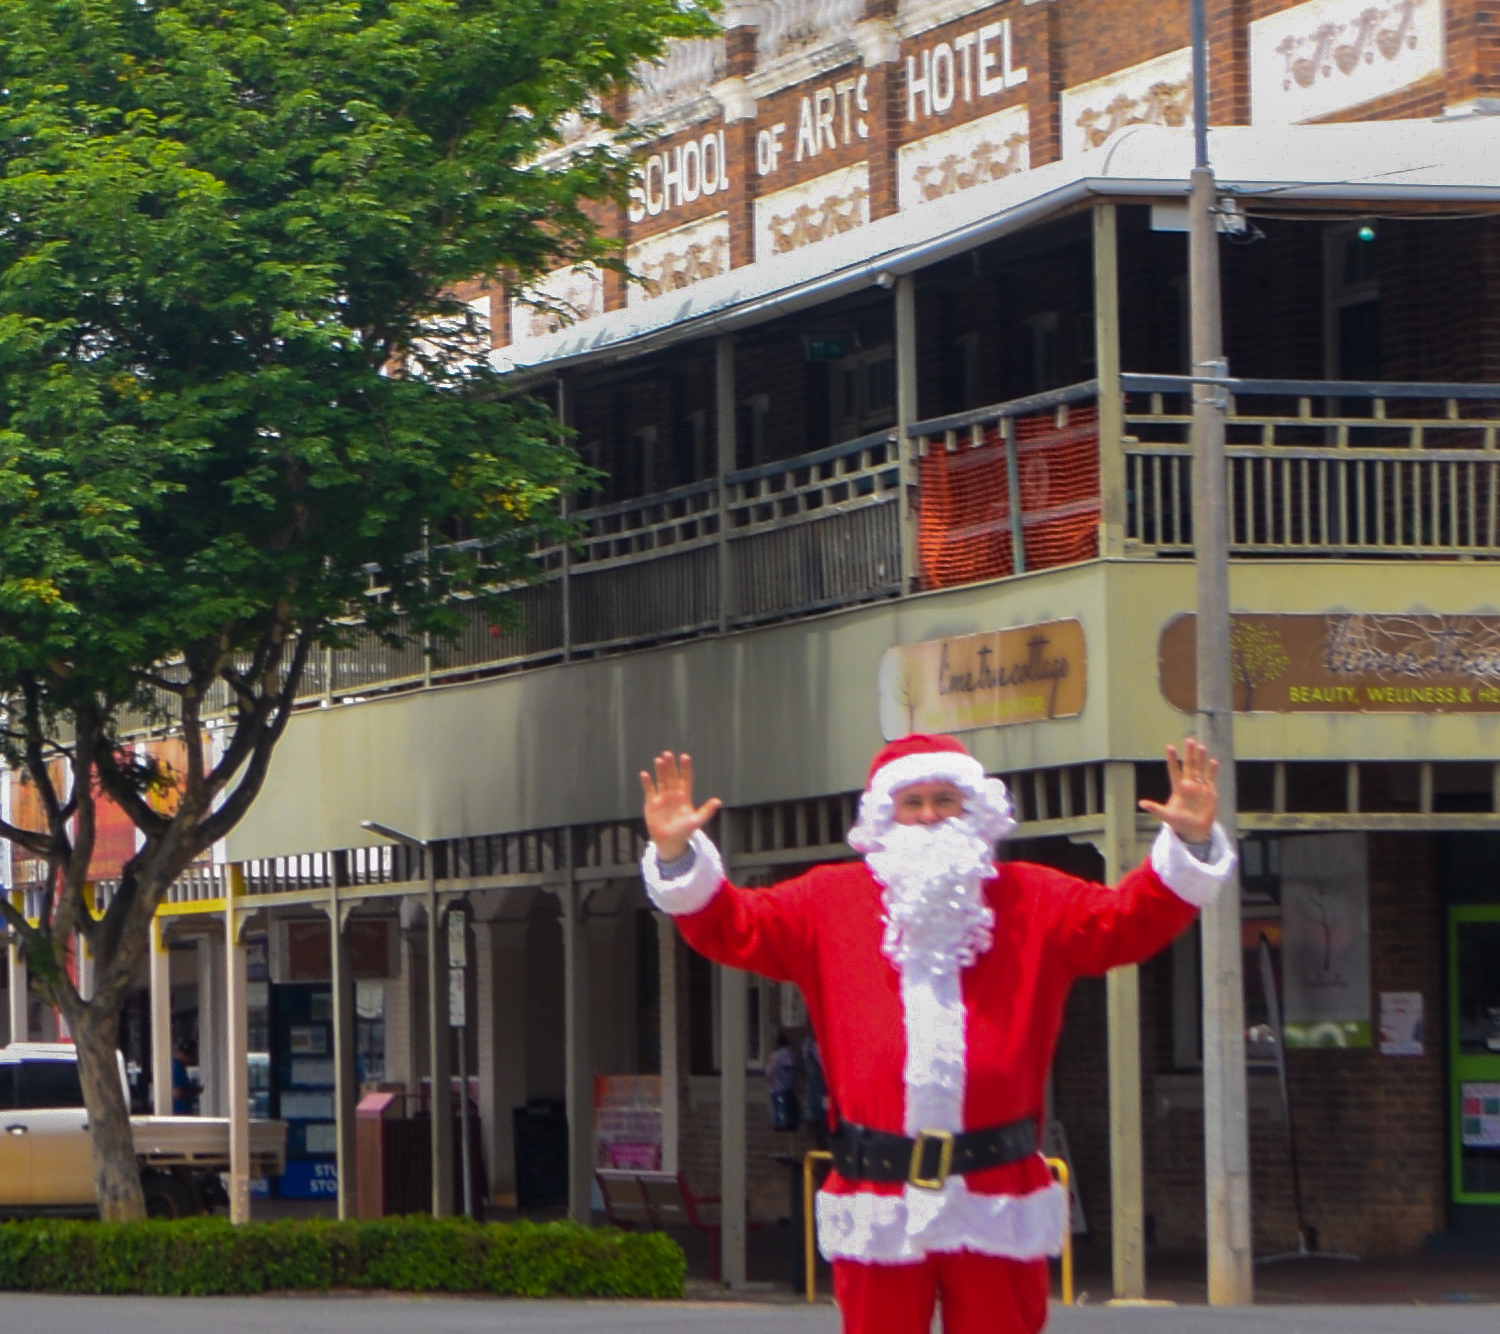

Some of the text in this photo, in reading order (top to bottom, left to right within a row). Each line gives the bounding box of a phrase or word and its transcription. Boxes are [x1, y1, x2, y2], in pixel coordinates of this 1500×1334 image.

[628, 18, 1028, 223] SCHOOL OF ARTS HOTEL
[1289, 686, 1360, 705] BEAUTY,
[1367, 686, 1455, 704] WELLNESS
[1459, 687, 1472, 704] &
[315, 1164, 337, 1177] STU
[310, 1179, 337, 1192] STO
